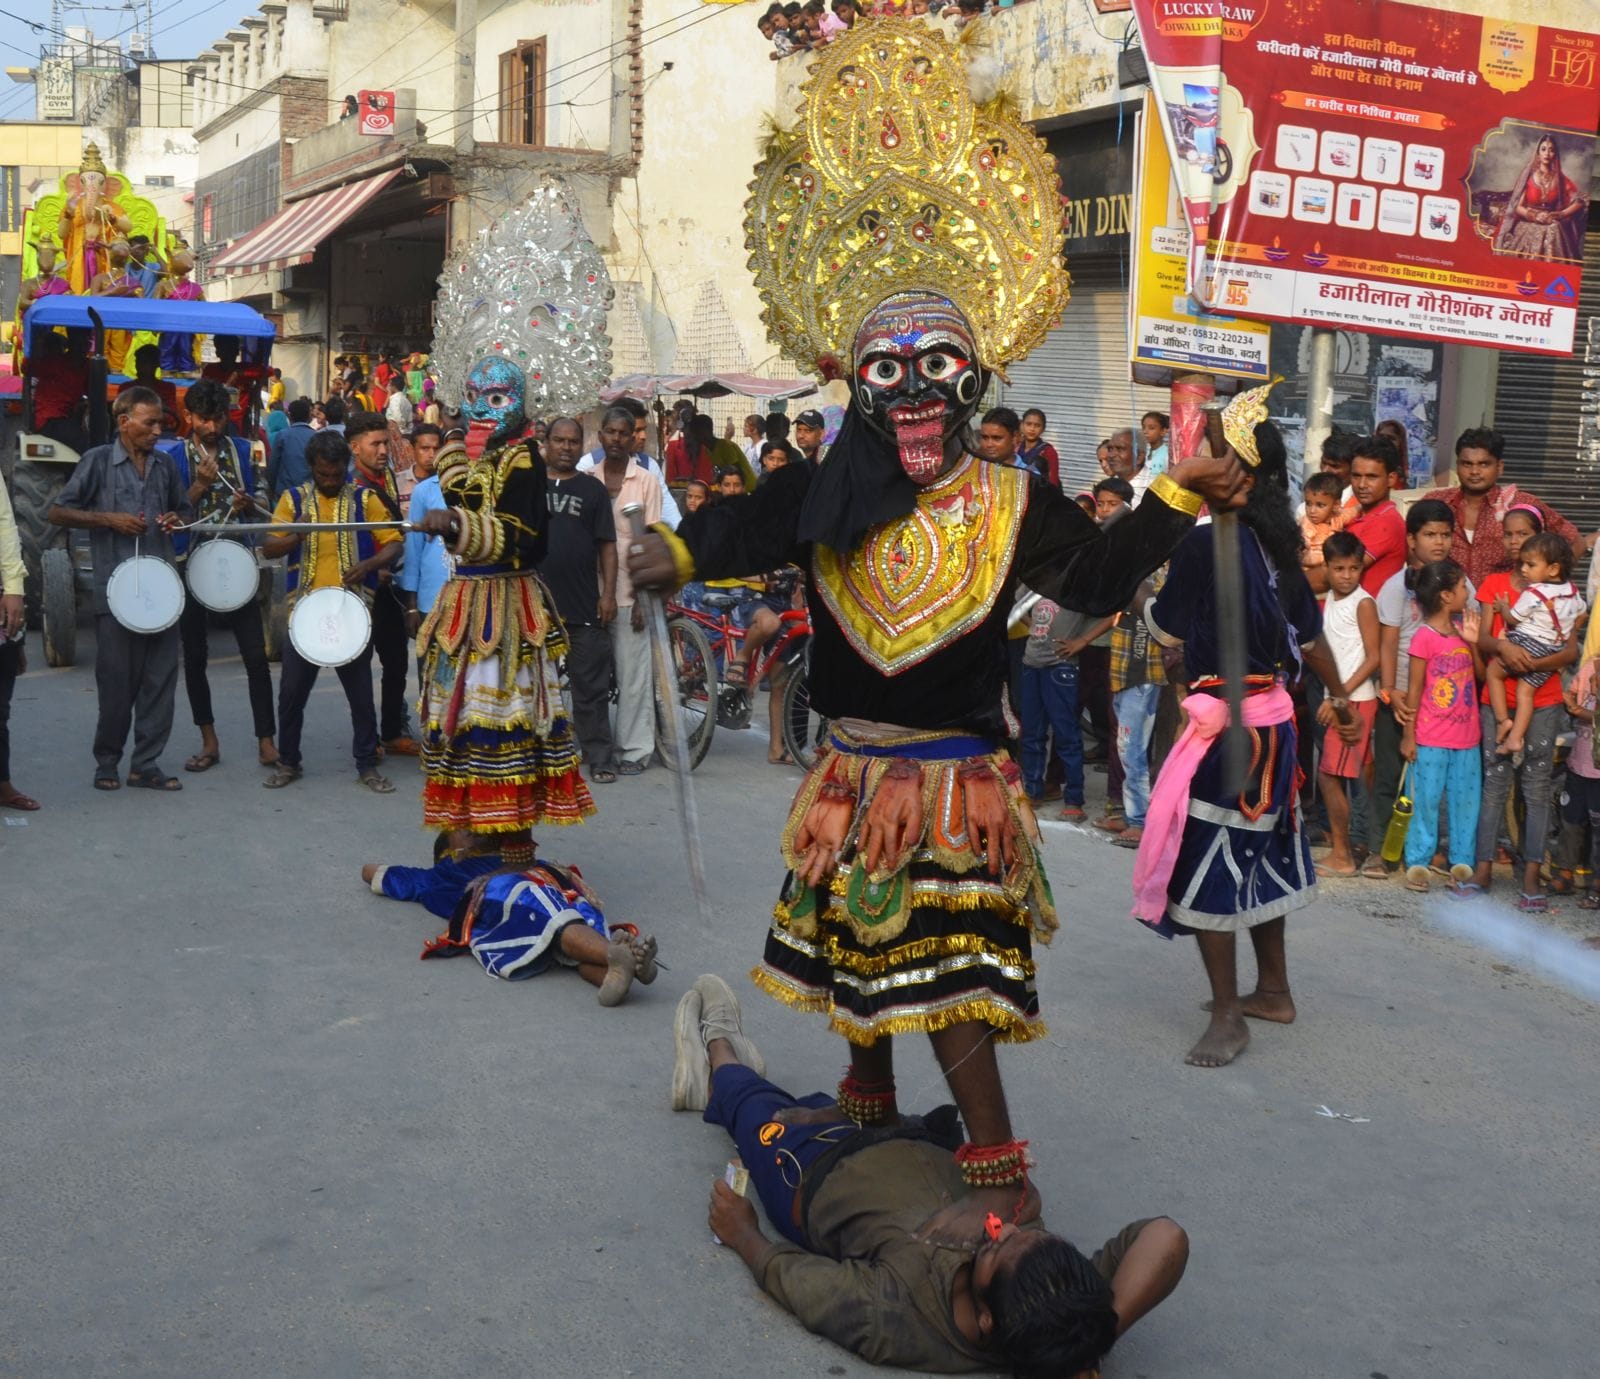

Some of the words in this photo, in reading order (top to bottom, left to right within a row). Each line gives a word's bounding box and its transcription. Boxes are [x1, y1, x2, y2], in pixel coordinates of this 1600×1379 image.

[1163, 3, 1214, 16] LUCKY
[1219, 3, 1256, 22] RAW
[1165, 22, 1201, 32] DIWALI
[1324, 33, 1340, 46] इस
[1343, 34, 1381, 51] दिवाली
[1384, 41, 1416, 57] सीजन
[1555, 34, 1575, 45] Since
[1577, 38, 1594, 48] 1930
[1257, 40, 1300, 56] खरीदारी
[1302, 46, 1321, 60] करें
[1322, 49, 1377, 69] हजारीलाल
[1380, 57, 1402, 73] गौरी
[1404, 62, 1429, 77] शंकर
[1431, 66, 1465, 83] ज्वेलर्स
[1467, 73, 1478, 85] से
[1311, 63, 1332, 77] और
[1335, 69, 1355, 81] पाए
[1357, 72, 1372, 84] ढेर
[1374, 73, 1392, 87] सारे
[1395, 78, 1423, 92] इनाम
[1305, 98, 1316, 107] हर
[1319, 98, 1343, 111] खरीद
[1346, 102, 1357, 114] पर
[1360, 103, 1391, 119] निश्चित
[1393, 111, 1420, 123] उपहार
[1157, 272, 1172, 281] Give
[1475, 280, 1495, 289] 2022
[1319, 281, 1412, 309] हजारीलाल
[1417, 291, 1495, 320] गौरीशंकर
[1499, 303, 1554, 328] ज्वेलर्स
[1153, 323, 1175, 333] सम्पर्क
[1176, 325, 1188, 335] करें
[1192, 328, 1254, 346] 05832-220234
[1161, 336, 1190, 350] ऑफिस
